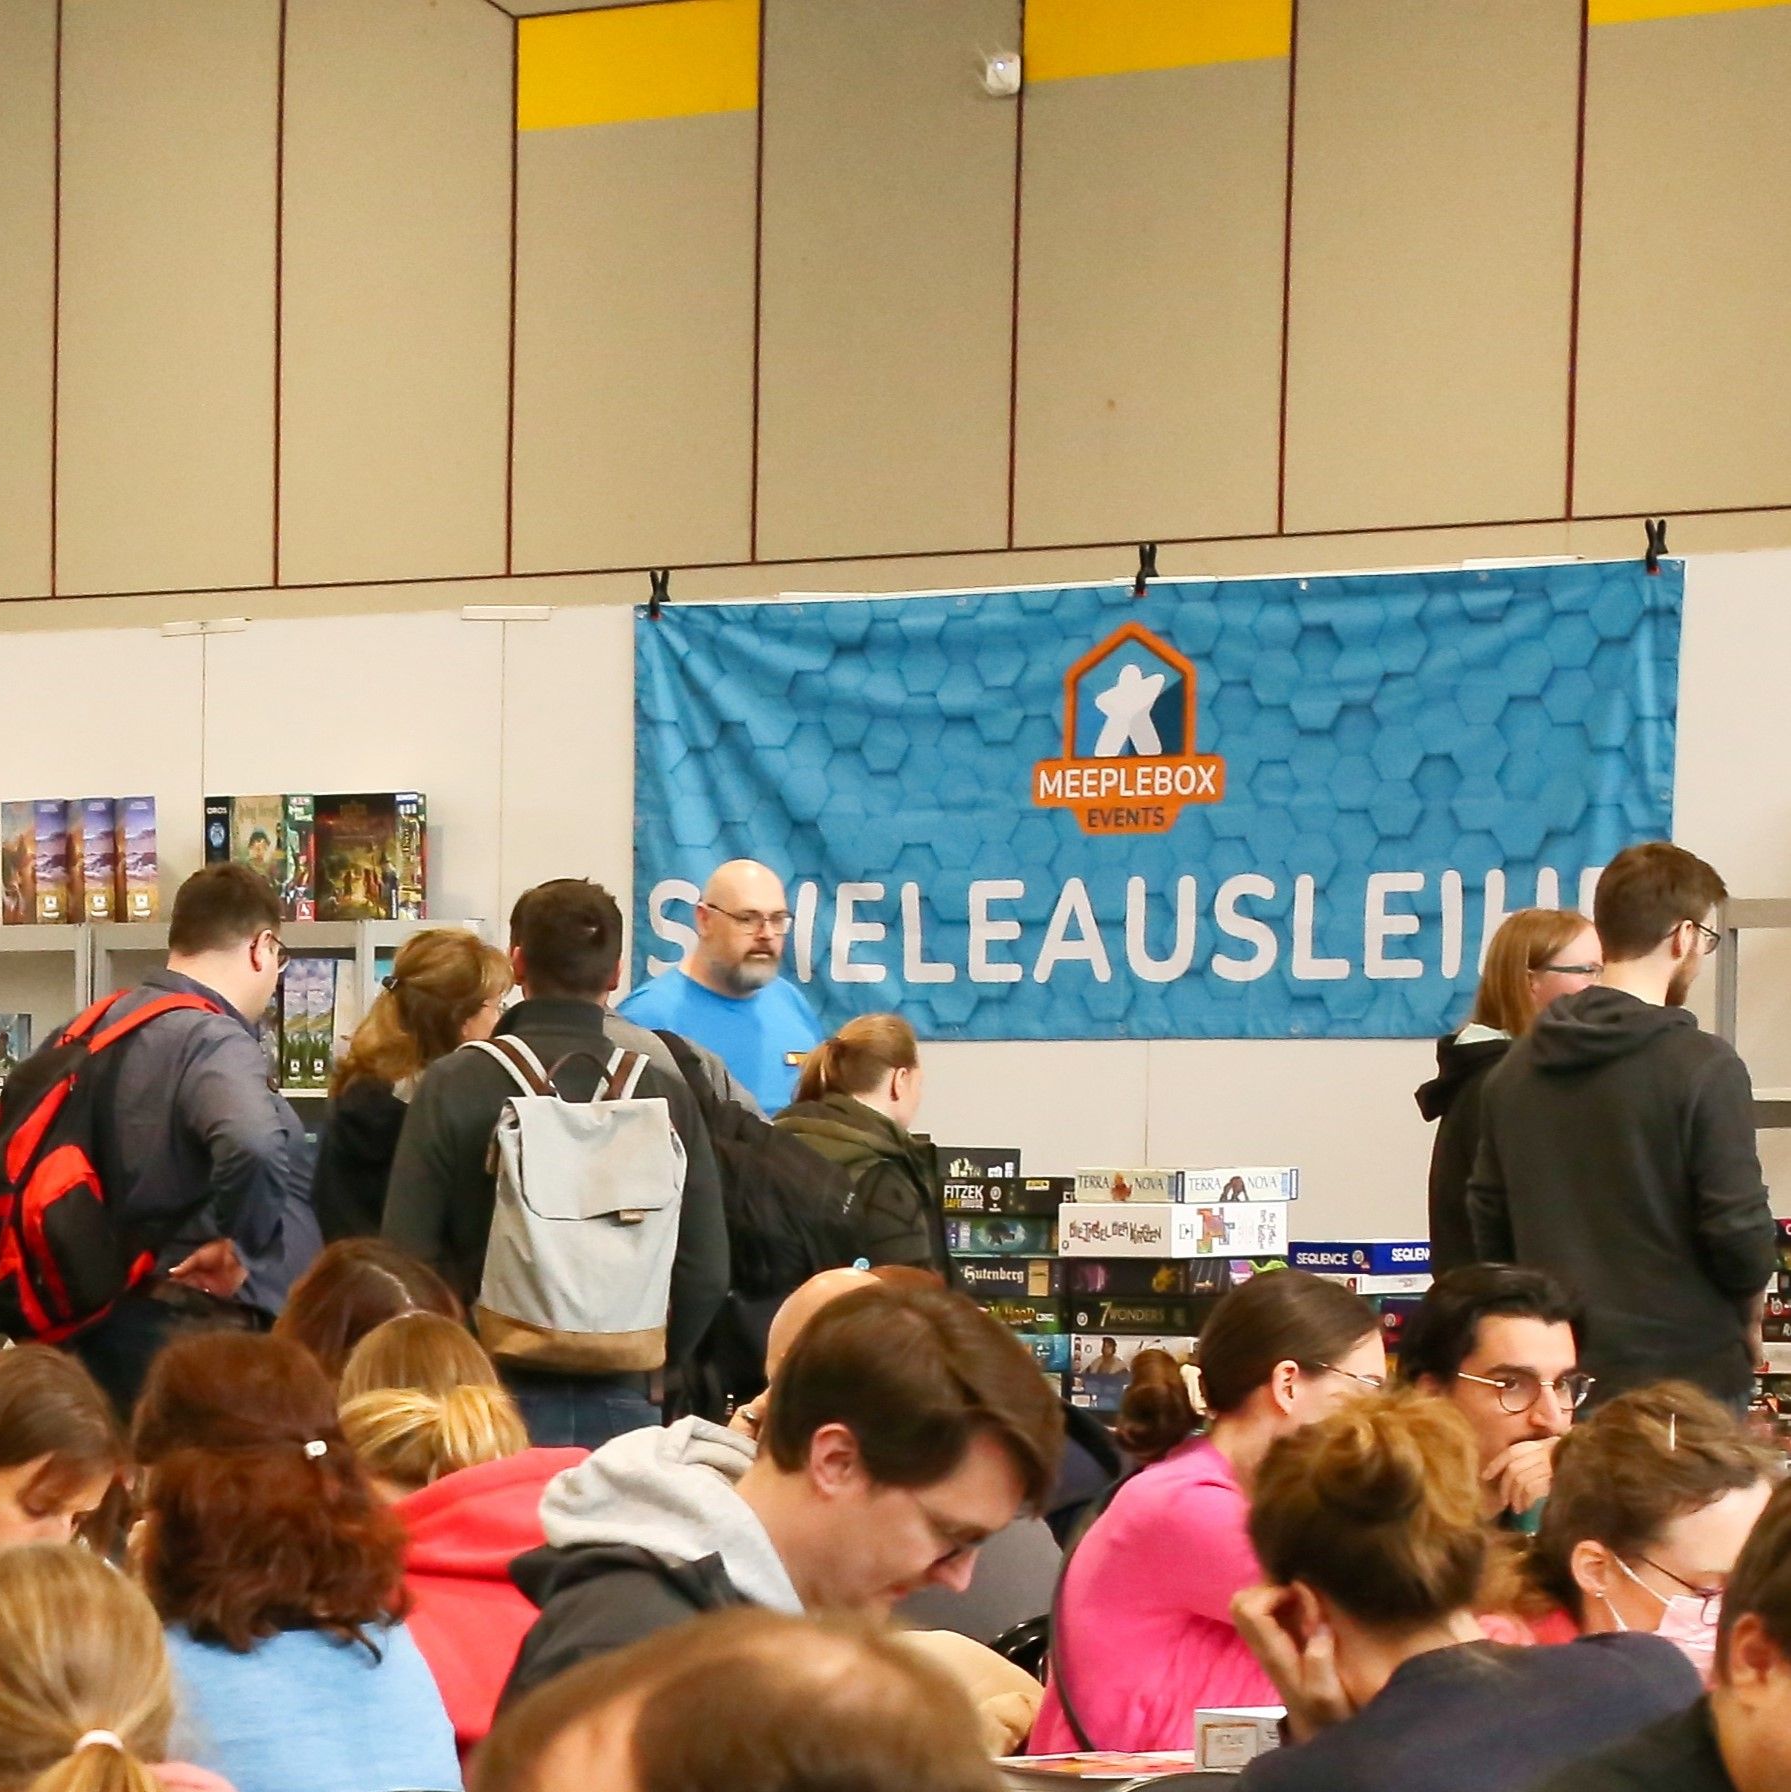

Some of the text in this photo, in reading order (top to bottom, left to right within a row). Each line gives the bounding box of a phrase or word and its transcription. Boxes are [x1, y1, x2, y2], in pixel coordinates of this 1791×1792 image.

[1038, 763, 1217, 799] MEEPLEBOX
[1087, 806, 1165, 829] EVENTS
[647, 866, 1604, 982] SIELEAUSLEIH
[943, 1184, 984, 1199] FITZEK
[1078, 1174, 1164, 1191] TERRA NOVA
[1188, 1175, 1278, 1191] TERRA NOVA
[1296, 1252, 1349, 1265] SEQUENCE
[1391, 1247, 1430, 1262] SEQUEN
[962, 1264, 1025, 1284] Gutenberg
[1099, 1301, 1113, 1328] 7
